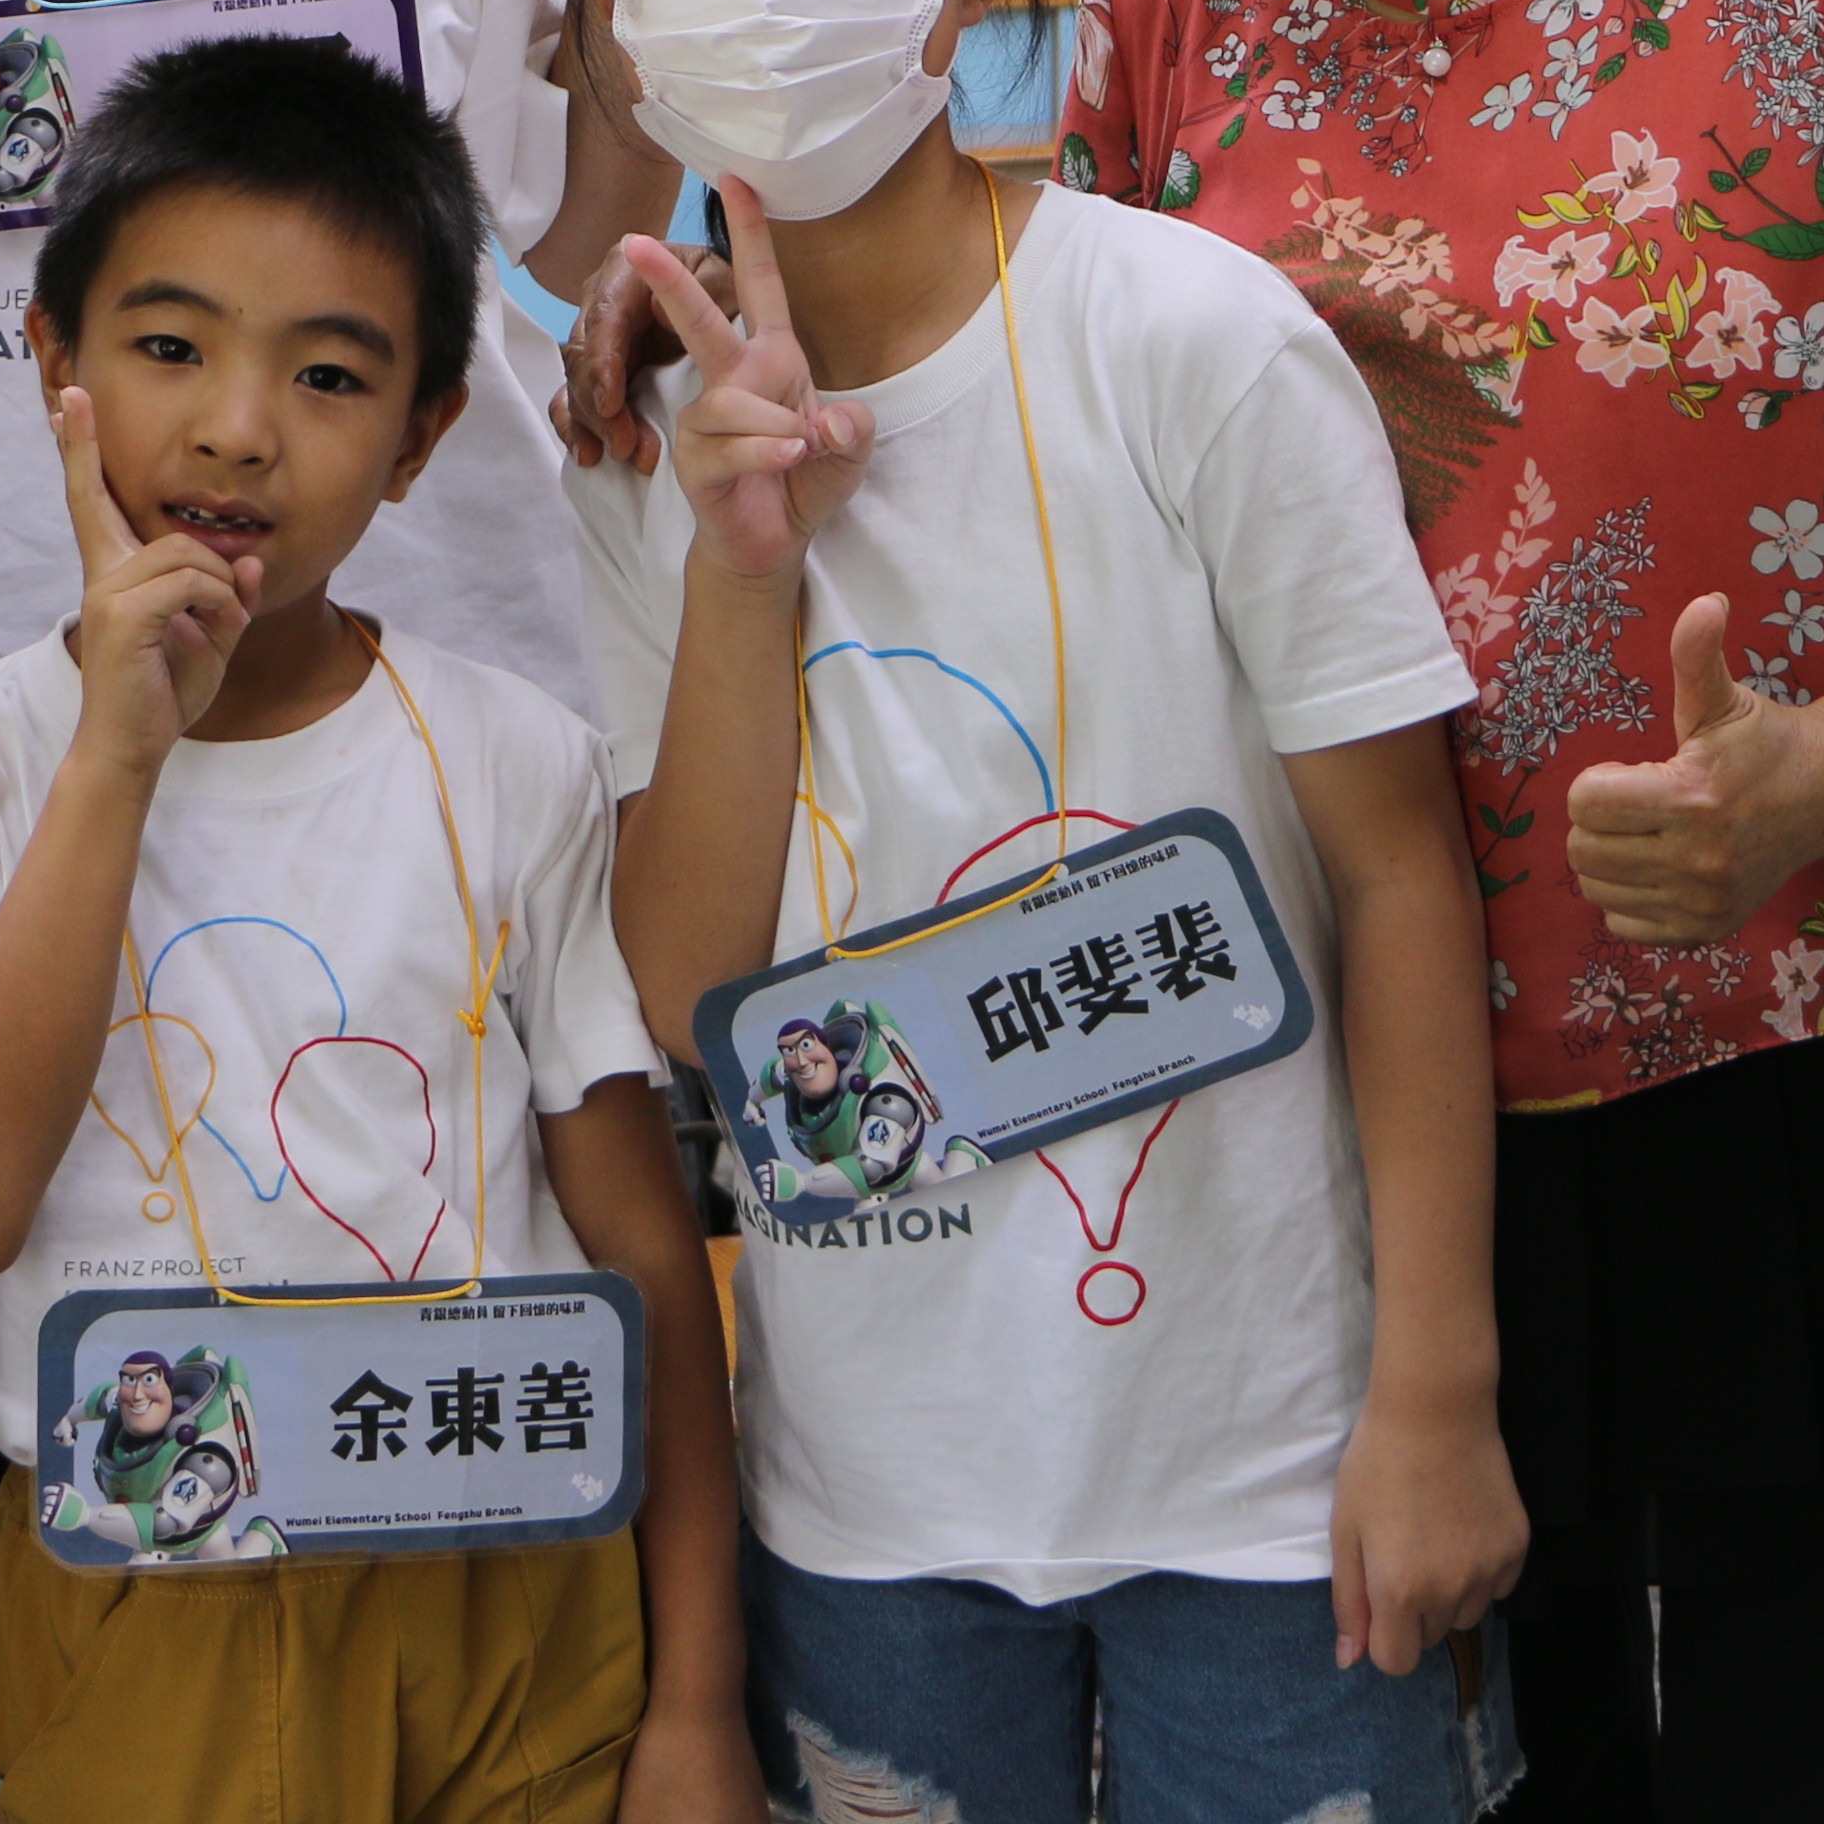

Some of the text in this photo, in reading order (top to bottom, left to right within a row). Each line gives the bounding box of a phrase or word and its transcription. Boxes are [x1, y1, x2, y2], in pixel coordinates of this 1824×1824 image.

[966, 900, 1238, 1063] 邱斐裴
[1012, 1099, 1073, 1127] Elementary
[1074, 1085, 1108, 1105] School
[1112, 1068, 1157, 1092] Fengshu
[1157, 1053, 1196, 1075] Branch
[736, 1187, 973, 1249] AGINATION
[64, 1256, 247, 1277] FRANZ PROJECT
[329, 1359, 595, 1462] 余東善
[325, 1513, 392, 1525] Elementary
[395, 1511, 432, 1522] School
[437, 1509, 483, 1521] Fengshu
[485, 1505, 523, 1517] Branch
